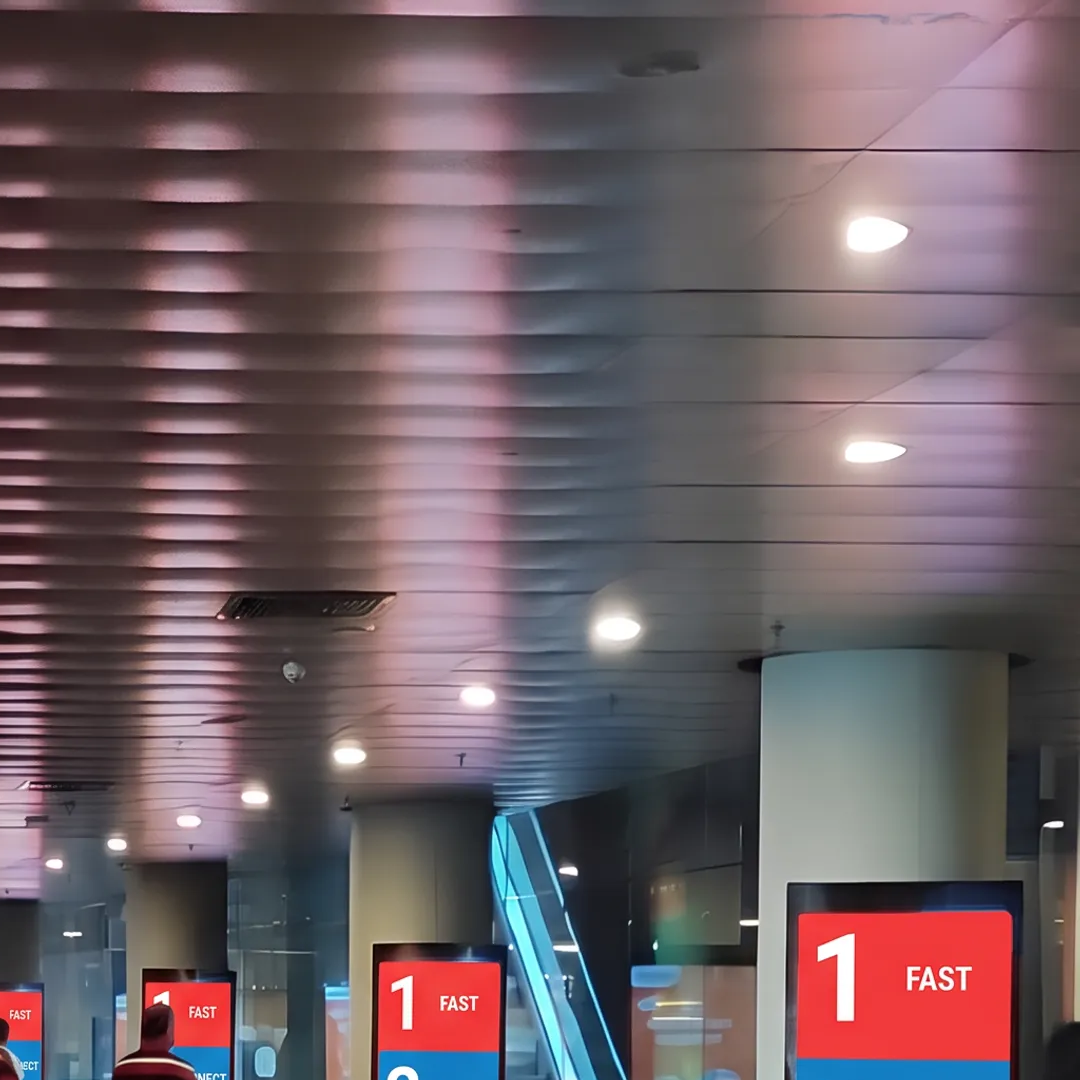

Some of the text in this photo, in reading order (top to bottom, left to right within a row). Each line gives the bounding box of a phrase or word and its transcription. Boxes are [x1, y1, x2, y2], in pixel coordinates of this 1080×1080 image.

[817, 933, 973, 1022] 1 FAST
[9, 1009, 32, 1020] FAST
[188, 1005, 218, 1019] FAST
[390, 975, 479, 1030] 1 FAST
